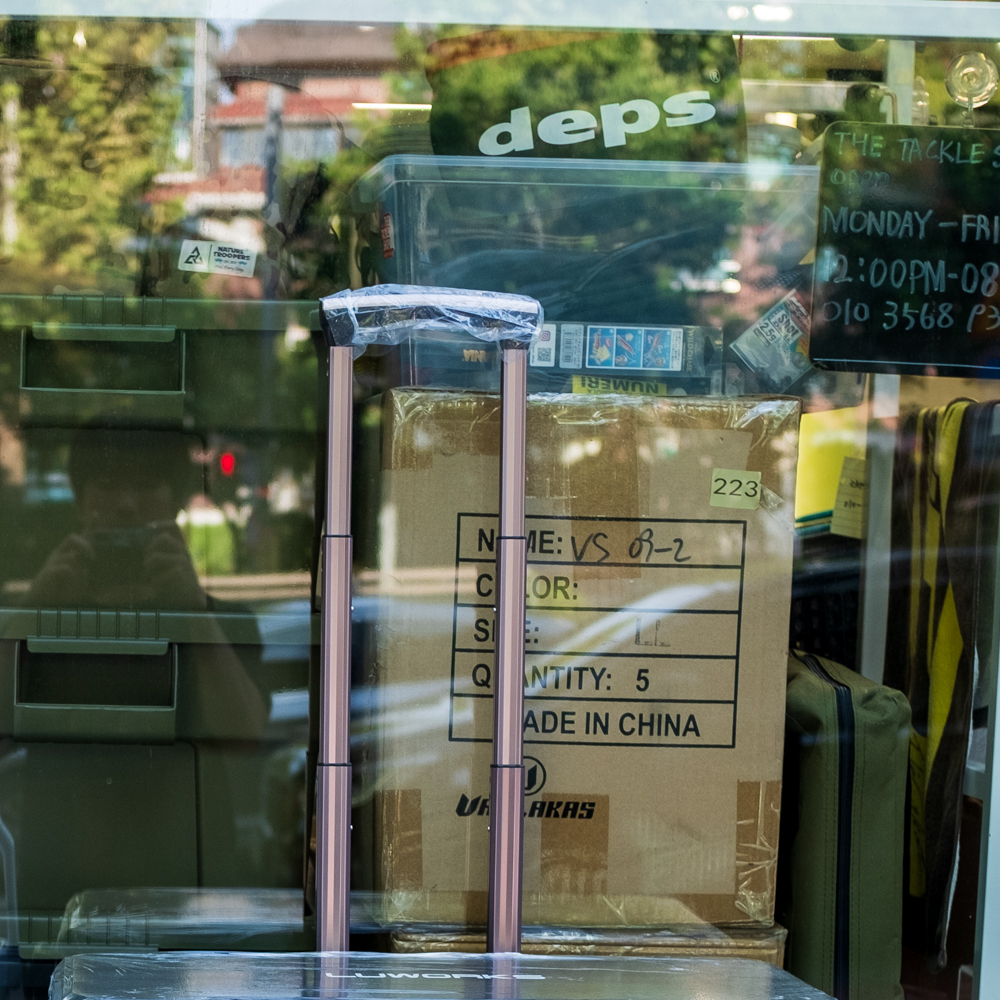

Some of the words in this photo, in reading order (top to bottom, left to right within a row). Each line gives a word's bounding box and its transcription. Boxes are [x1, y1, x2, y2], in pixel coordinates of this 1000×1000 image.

[478, 90, 716, 156] deps
[834, 132, 884, 158] THE
[898, 137, 986, 164] TACKLE
[213, 251, 251, 261] TROOPERS
[882, 301, 955, 331] 3568
[580, 376, 659, 395] NUMERI
[713, 477, 758, 498] 223
[478, 528, 562, 555] NME:
[476, 573, 578, 601] COR:
[472, 663, 612, 691] QNTITY:
[635, 668, 650, 693] 5
[523, 709, 576, 735] ADE
[585, 711, 609, 736] IN
[618, 712, 700, 738] CHINA
